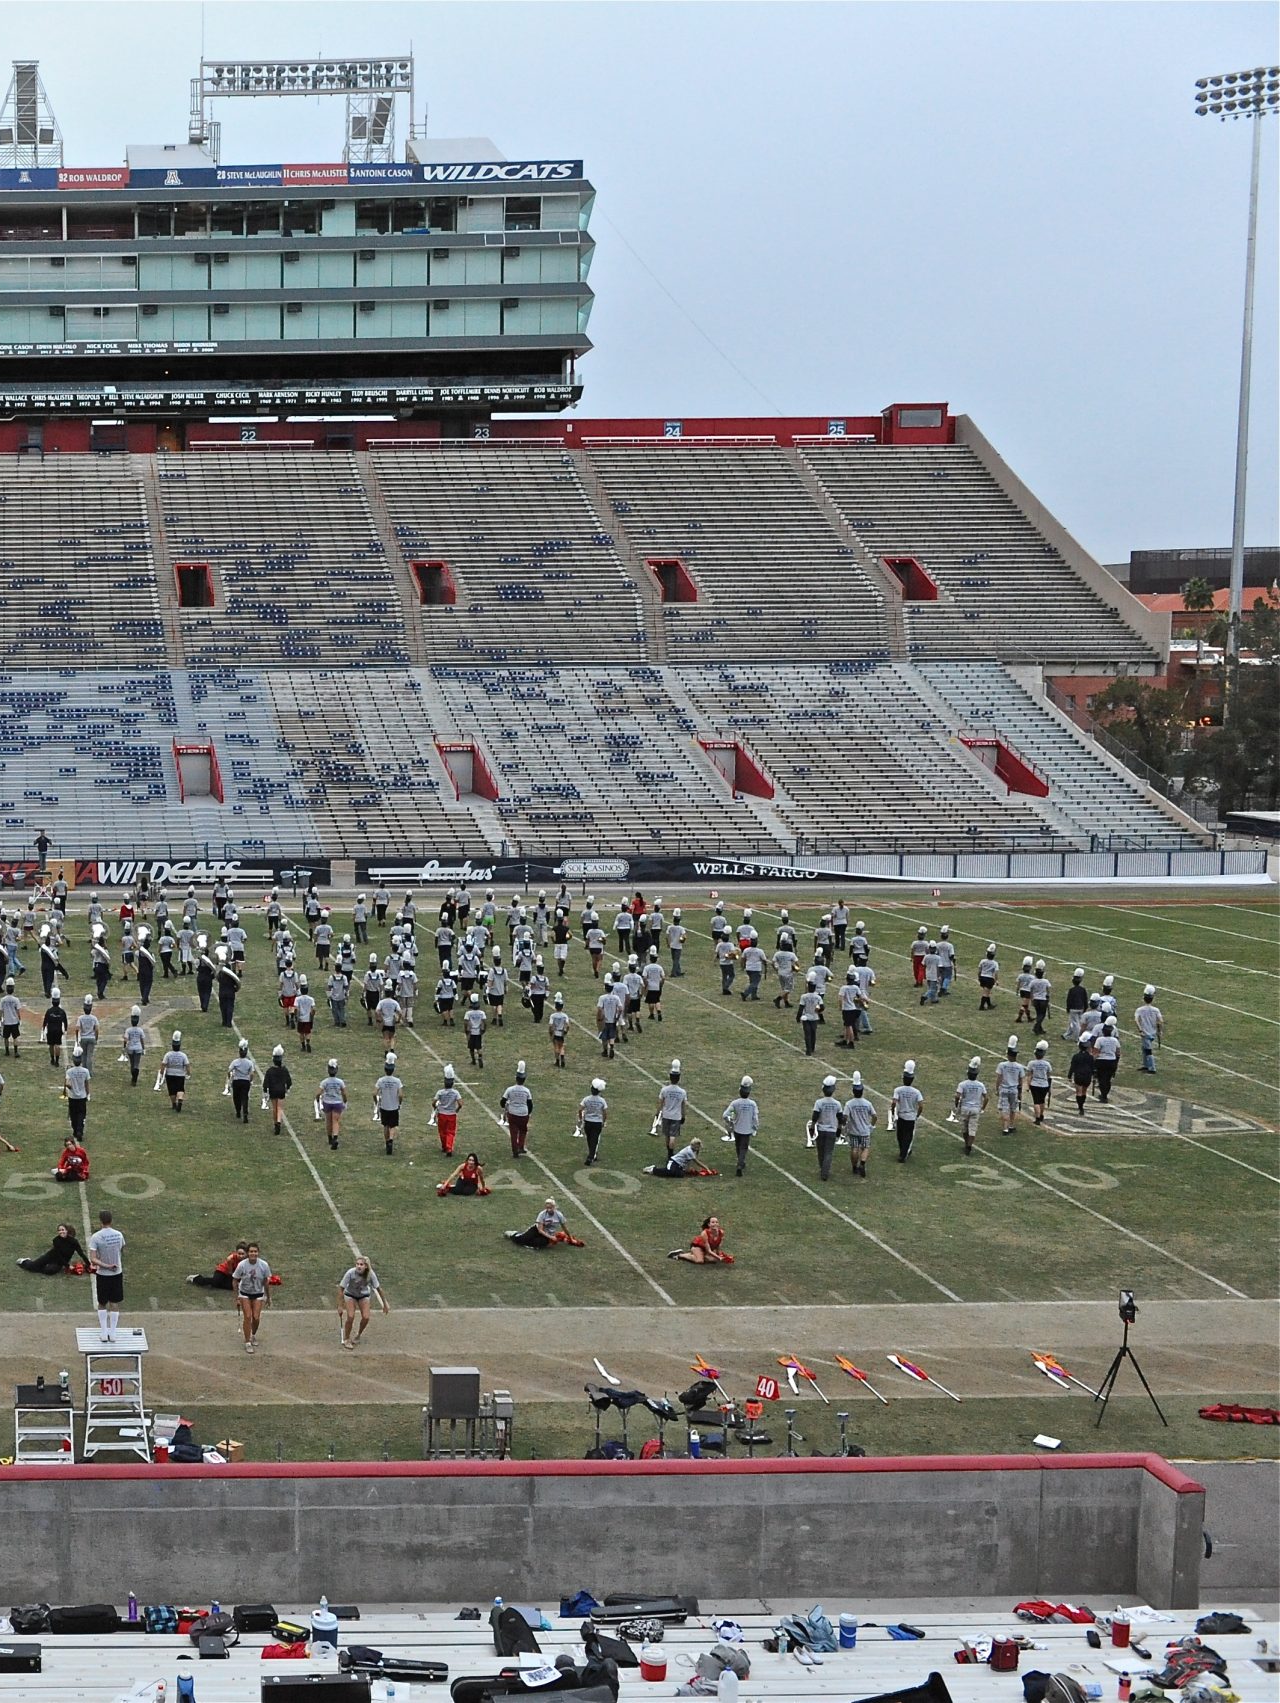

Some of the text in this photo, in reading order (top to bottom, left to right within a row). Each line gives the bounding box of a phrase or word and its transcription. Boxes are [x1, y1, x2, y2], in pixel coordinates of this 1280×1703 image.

[217, 171, 226, 179] 28
[424, 164, 574, 180] WILDCATS
[59, 173, 68, 181] 92
[86, 174, 122, 182] WALDROP
[241, 431, 256, 441] 22
[475, 428, 489, 438] 23
[666, 427, 680, 437] 24
[830, 426, 844, 436] 25
[693, 863, 754, 875] WELLS
[103, 1378, 121, 1395] 50
[758, 1378, 775, 1398] 40
